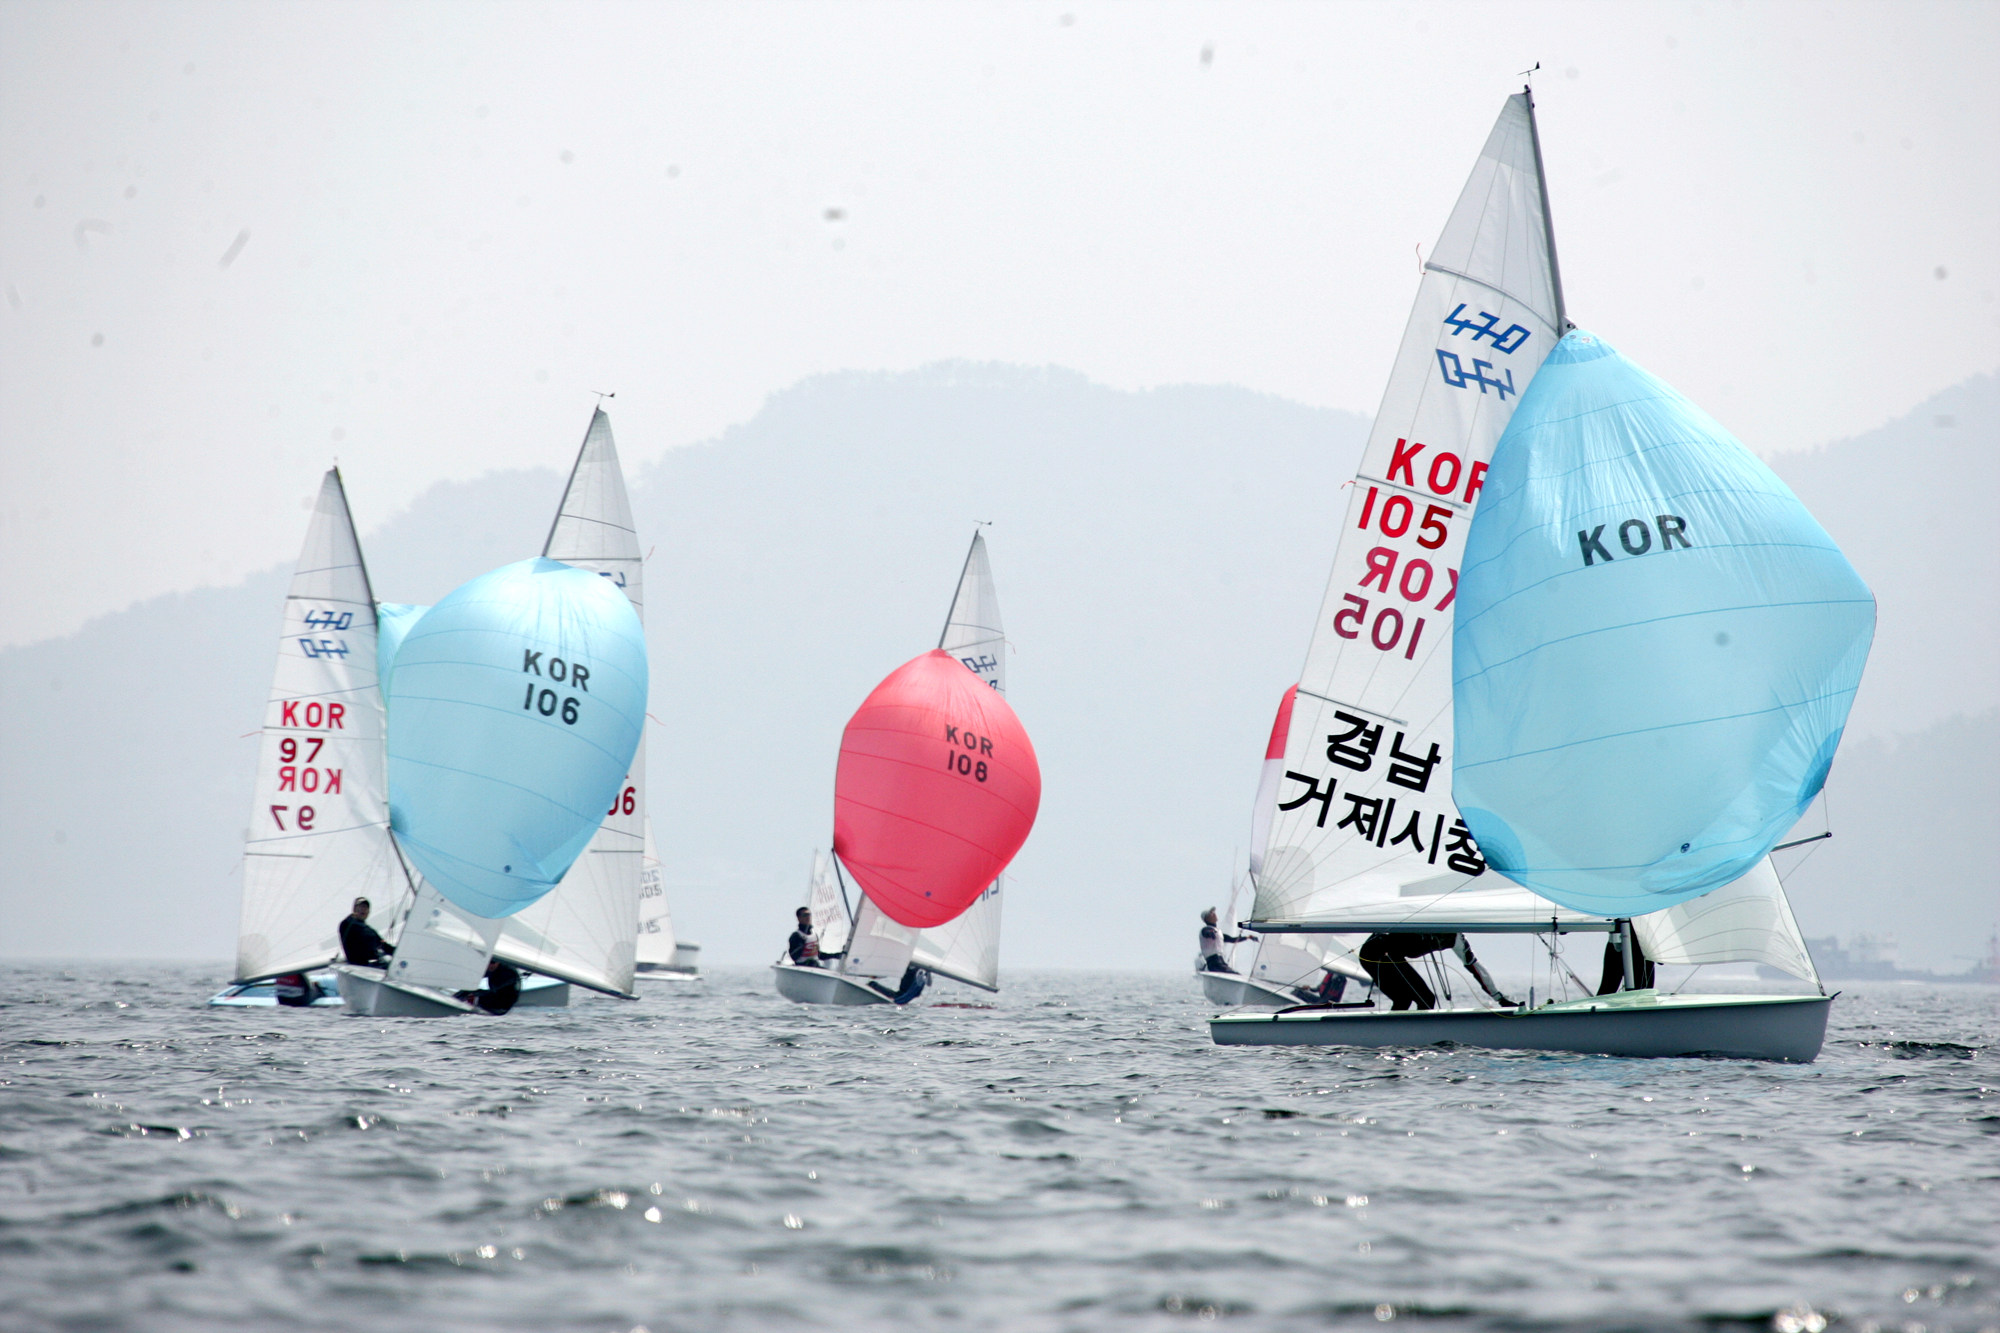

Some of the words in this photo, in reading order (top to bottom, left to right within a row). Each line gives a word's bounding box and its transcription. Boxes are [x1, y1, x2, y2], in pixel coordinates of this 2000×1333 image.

[1443, 303, 1531, 354] 470
[1358, 486, 1453, 549] 105
[1577, 514, 1692, 566] KOR
[304, 609, 353, 630] 470
[523, 649, 590, 692] KOR
[282, 700, 345, 729] KOR
[524, 683, 581, 725] 106
[279, 737, 323, 763] 97
[946, 724, 993, 759] KOR
[1326, 710, 1441, 793] 경남
[948, 749, 988, 782] 108
[1278, 770, 1486, 876] 거제시청
